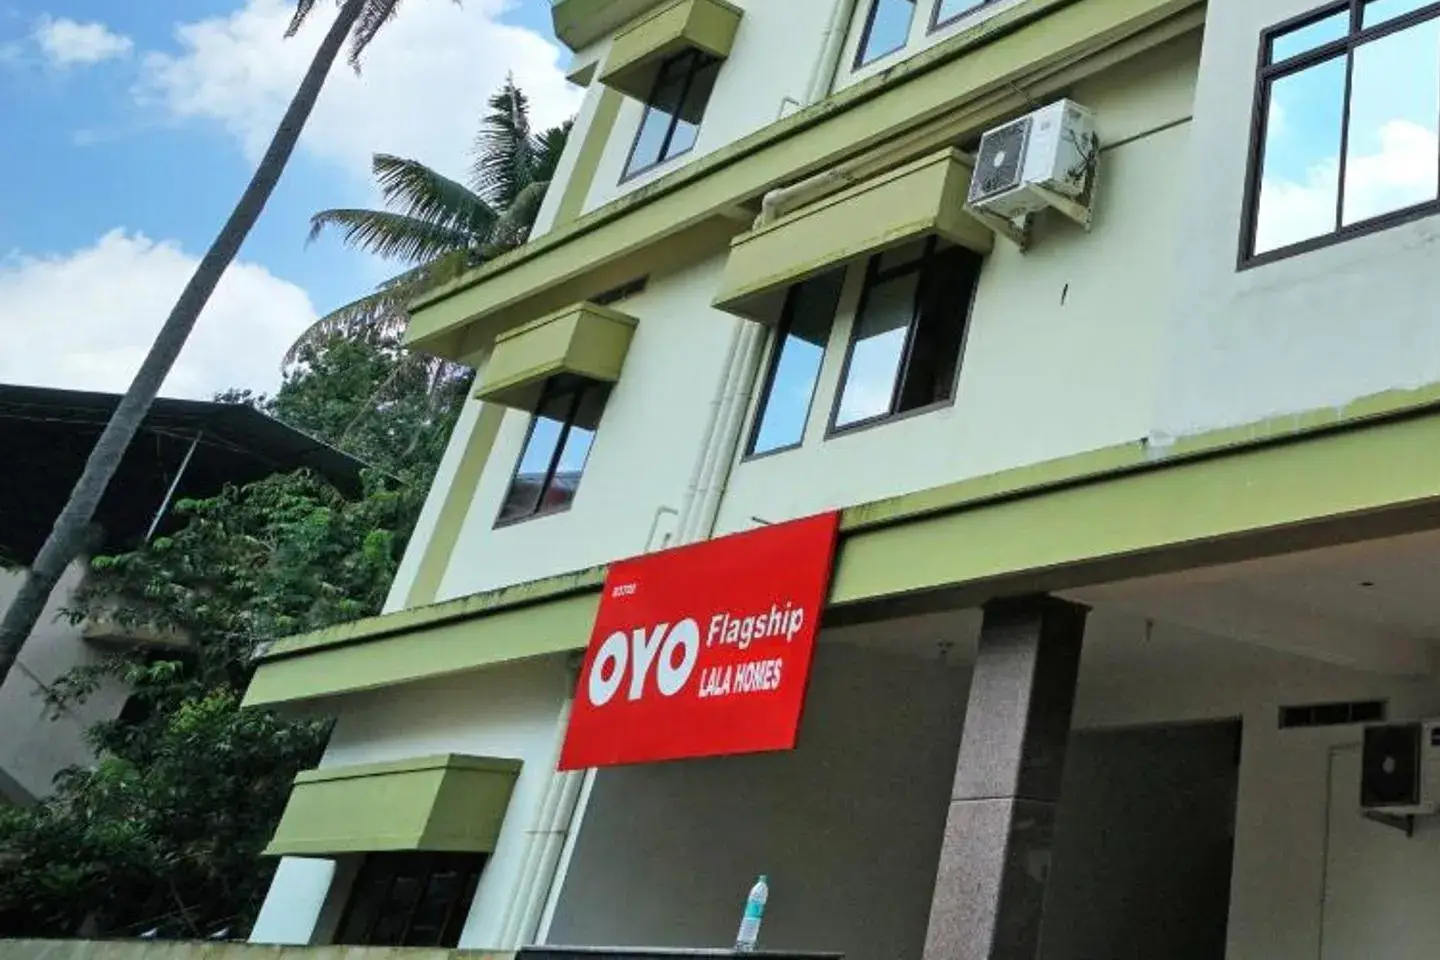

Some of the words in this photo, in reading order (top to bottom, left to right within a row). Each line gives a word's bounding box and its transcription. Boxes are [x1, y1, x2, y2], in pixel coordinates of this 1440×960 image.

[706, 601, 803, 650] Flagship
[588, 618, 700, 707] OYO
[699, 664, 732, 699] LALA
[733, 657, 783, 693] HOMES
